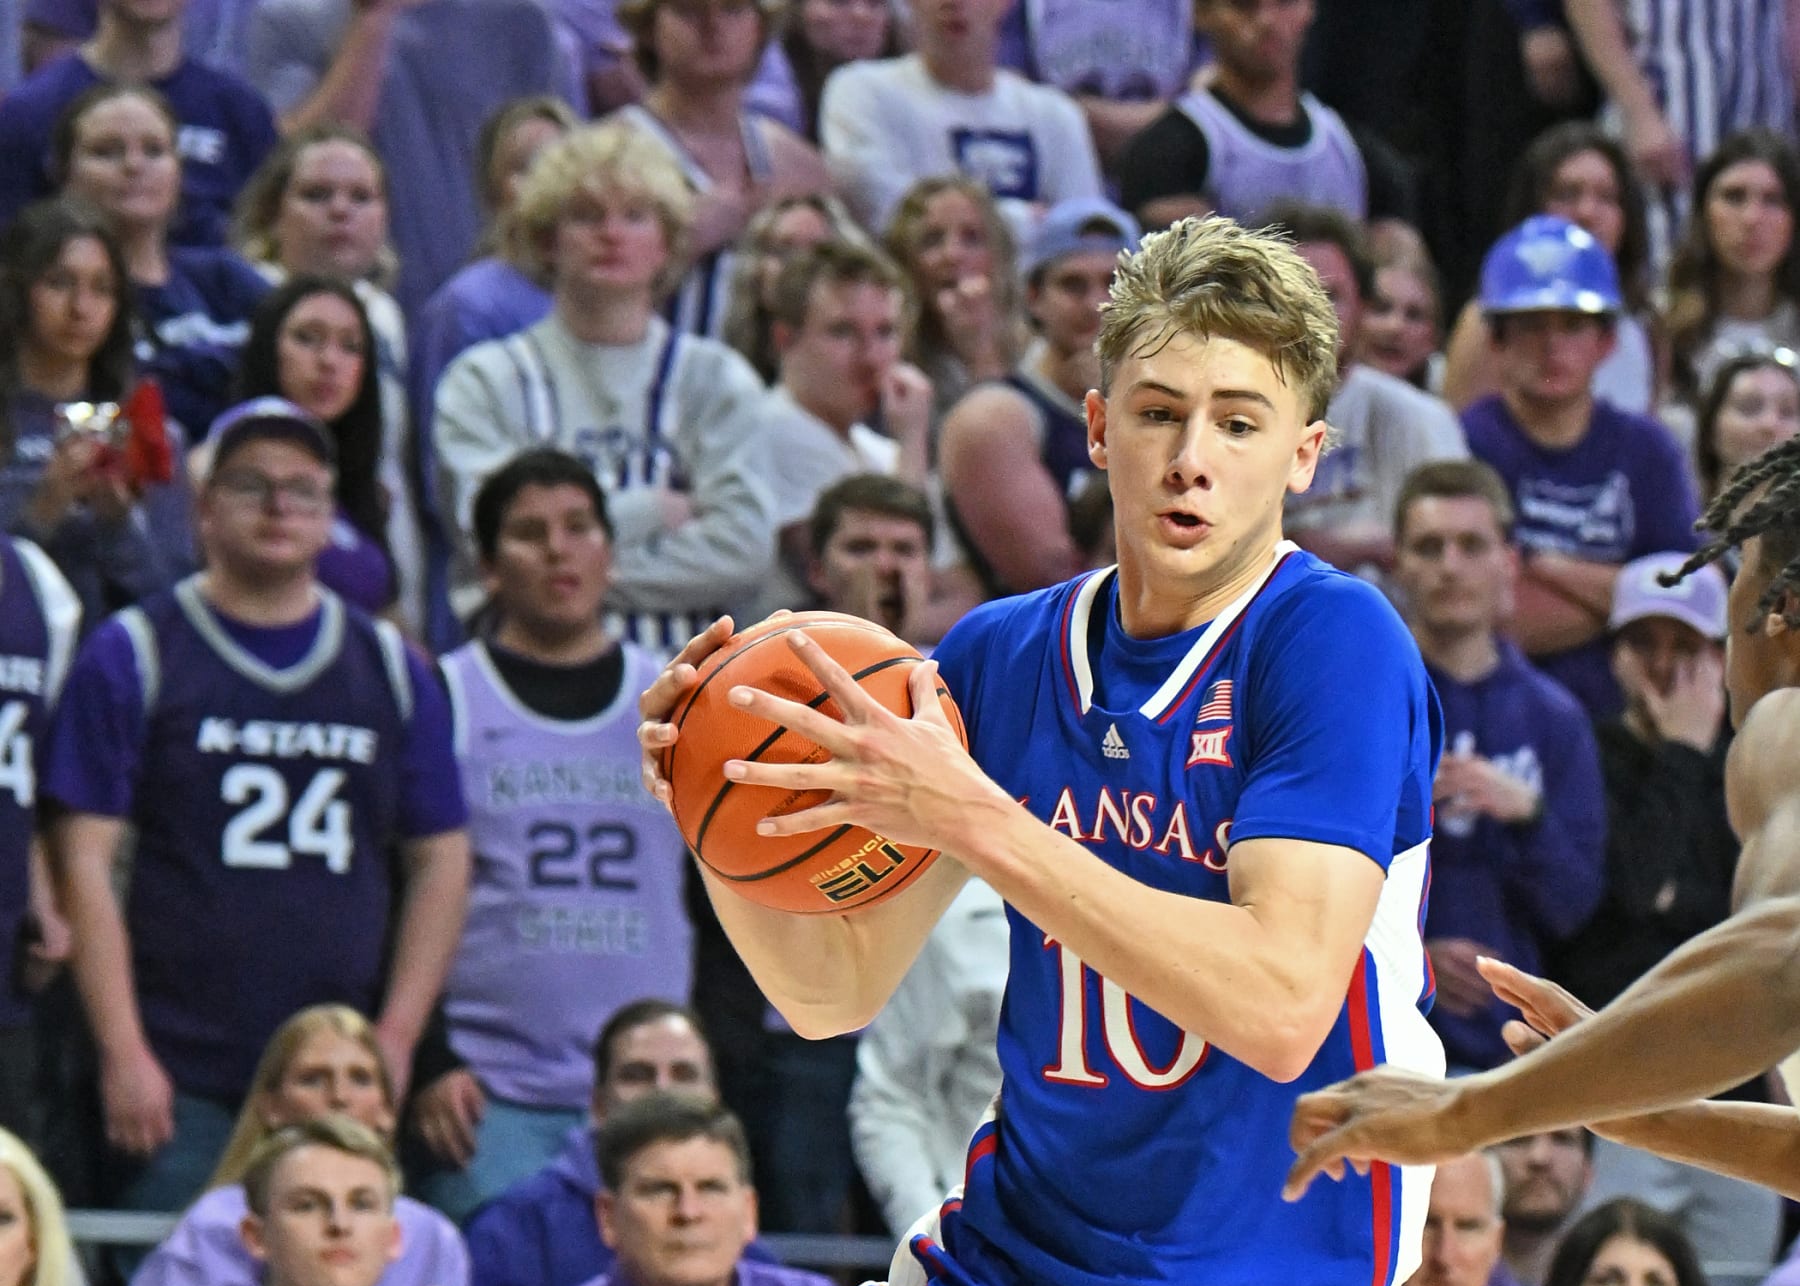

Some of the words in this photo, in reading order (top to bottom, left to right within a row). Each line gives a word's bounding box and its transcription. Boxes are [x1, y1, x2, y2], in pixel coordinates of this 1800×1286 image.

[197, 716, 378, 765] K-STATE
[221, 762, 354, 874] 24
[527, 819, 640, 892] 22
[1017, 785, 1233, 874] ANSAS
